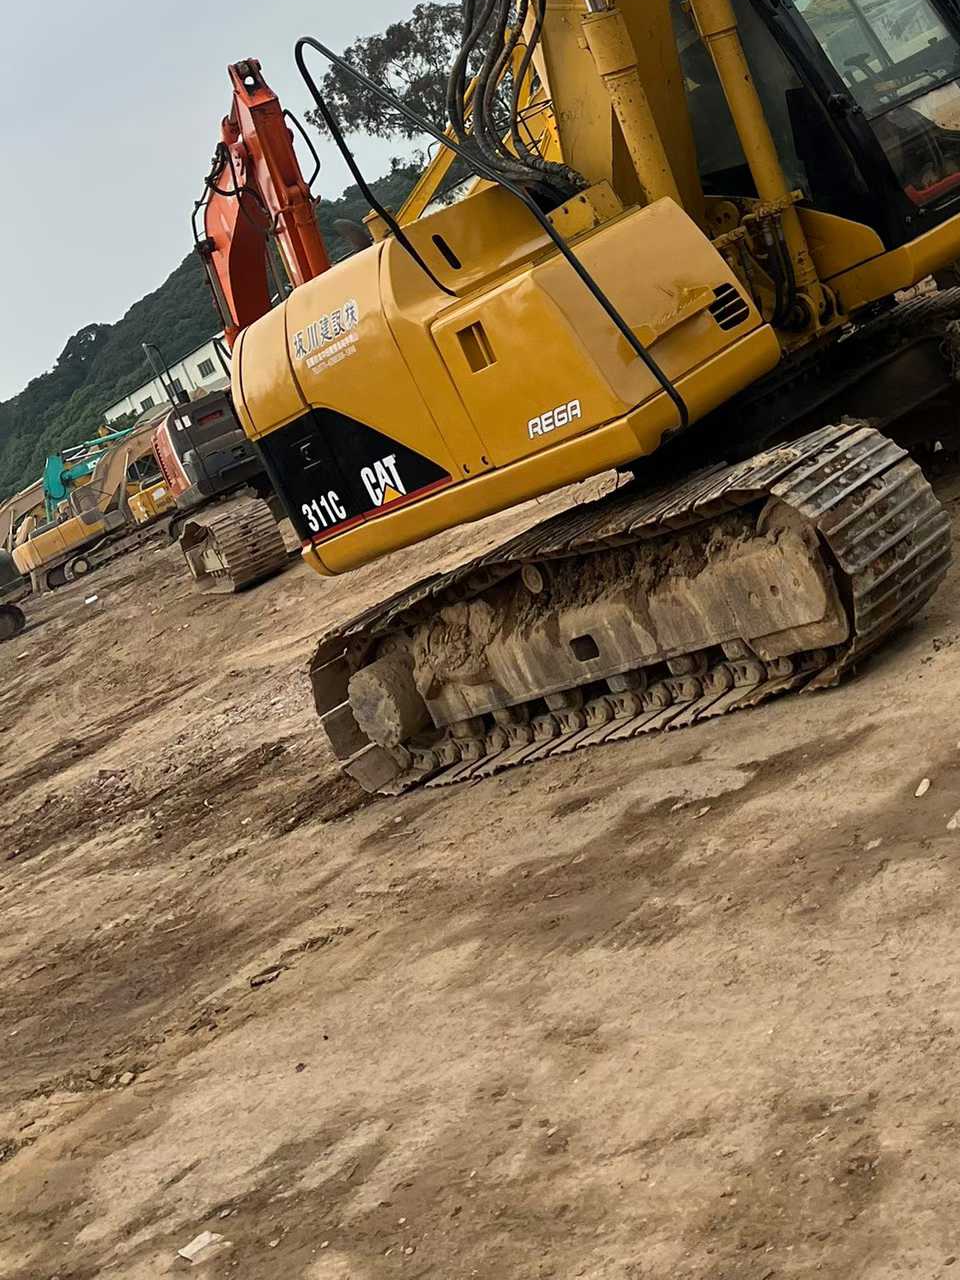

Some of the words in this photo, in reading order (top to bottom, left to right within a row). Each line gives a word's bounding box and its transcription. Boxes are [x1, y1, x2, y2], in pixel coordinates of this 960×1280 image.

[528, 399, 581, 439] REGA
[301, 490, 347, 532] 311C
[360, 454, 407, 507] CAT
